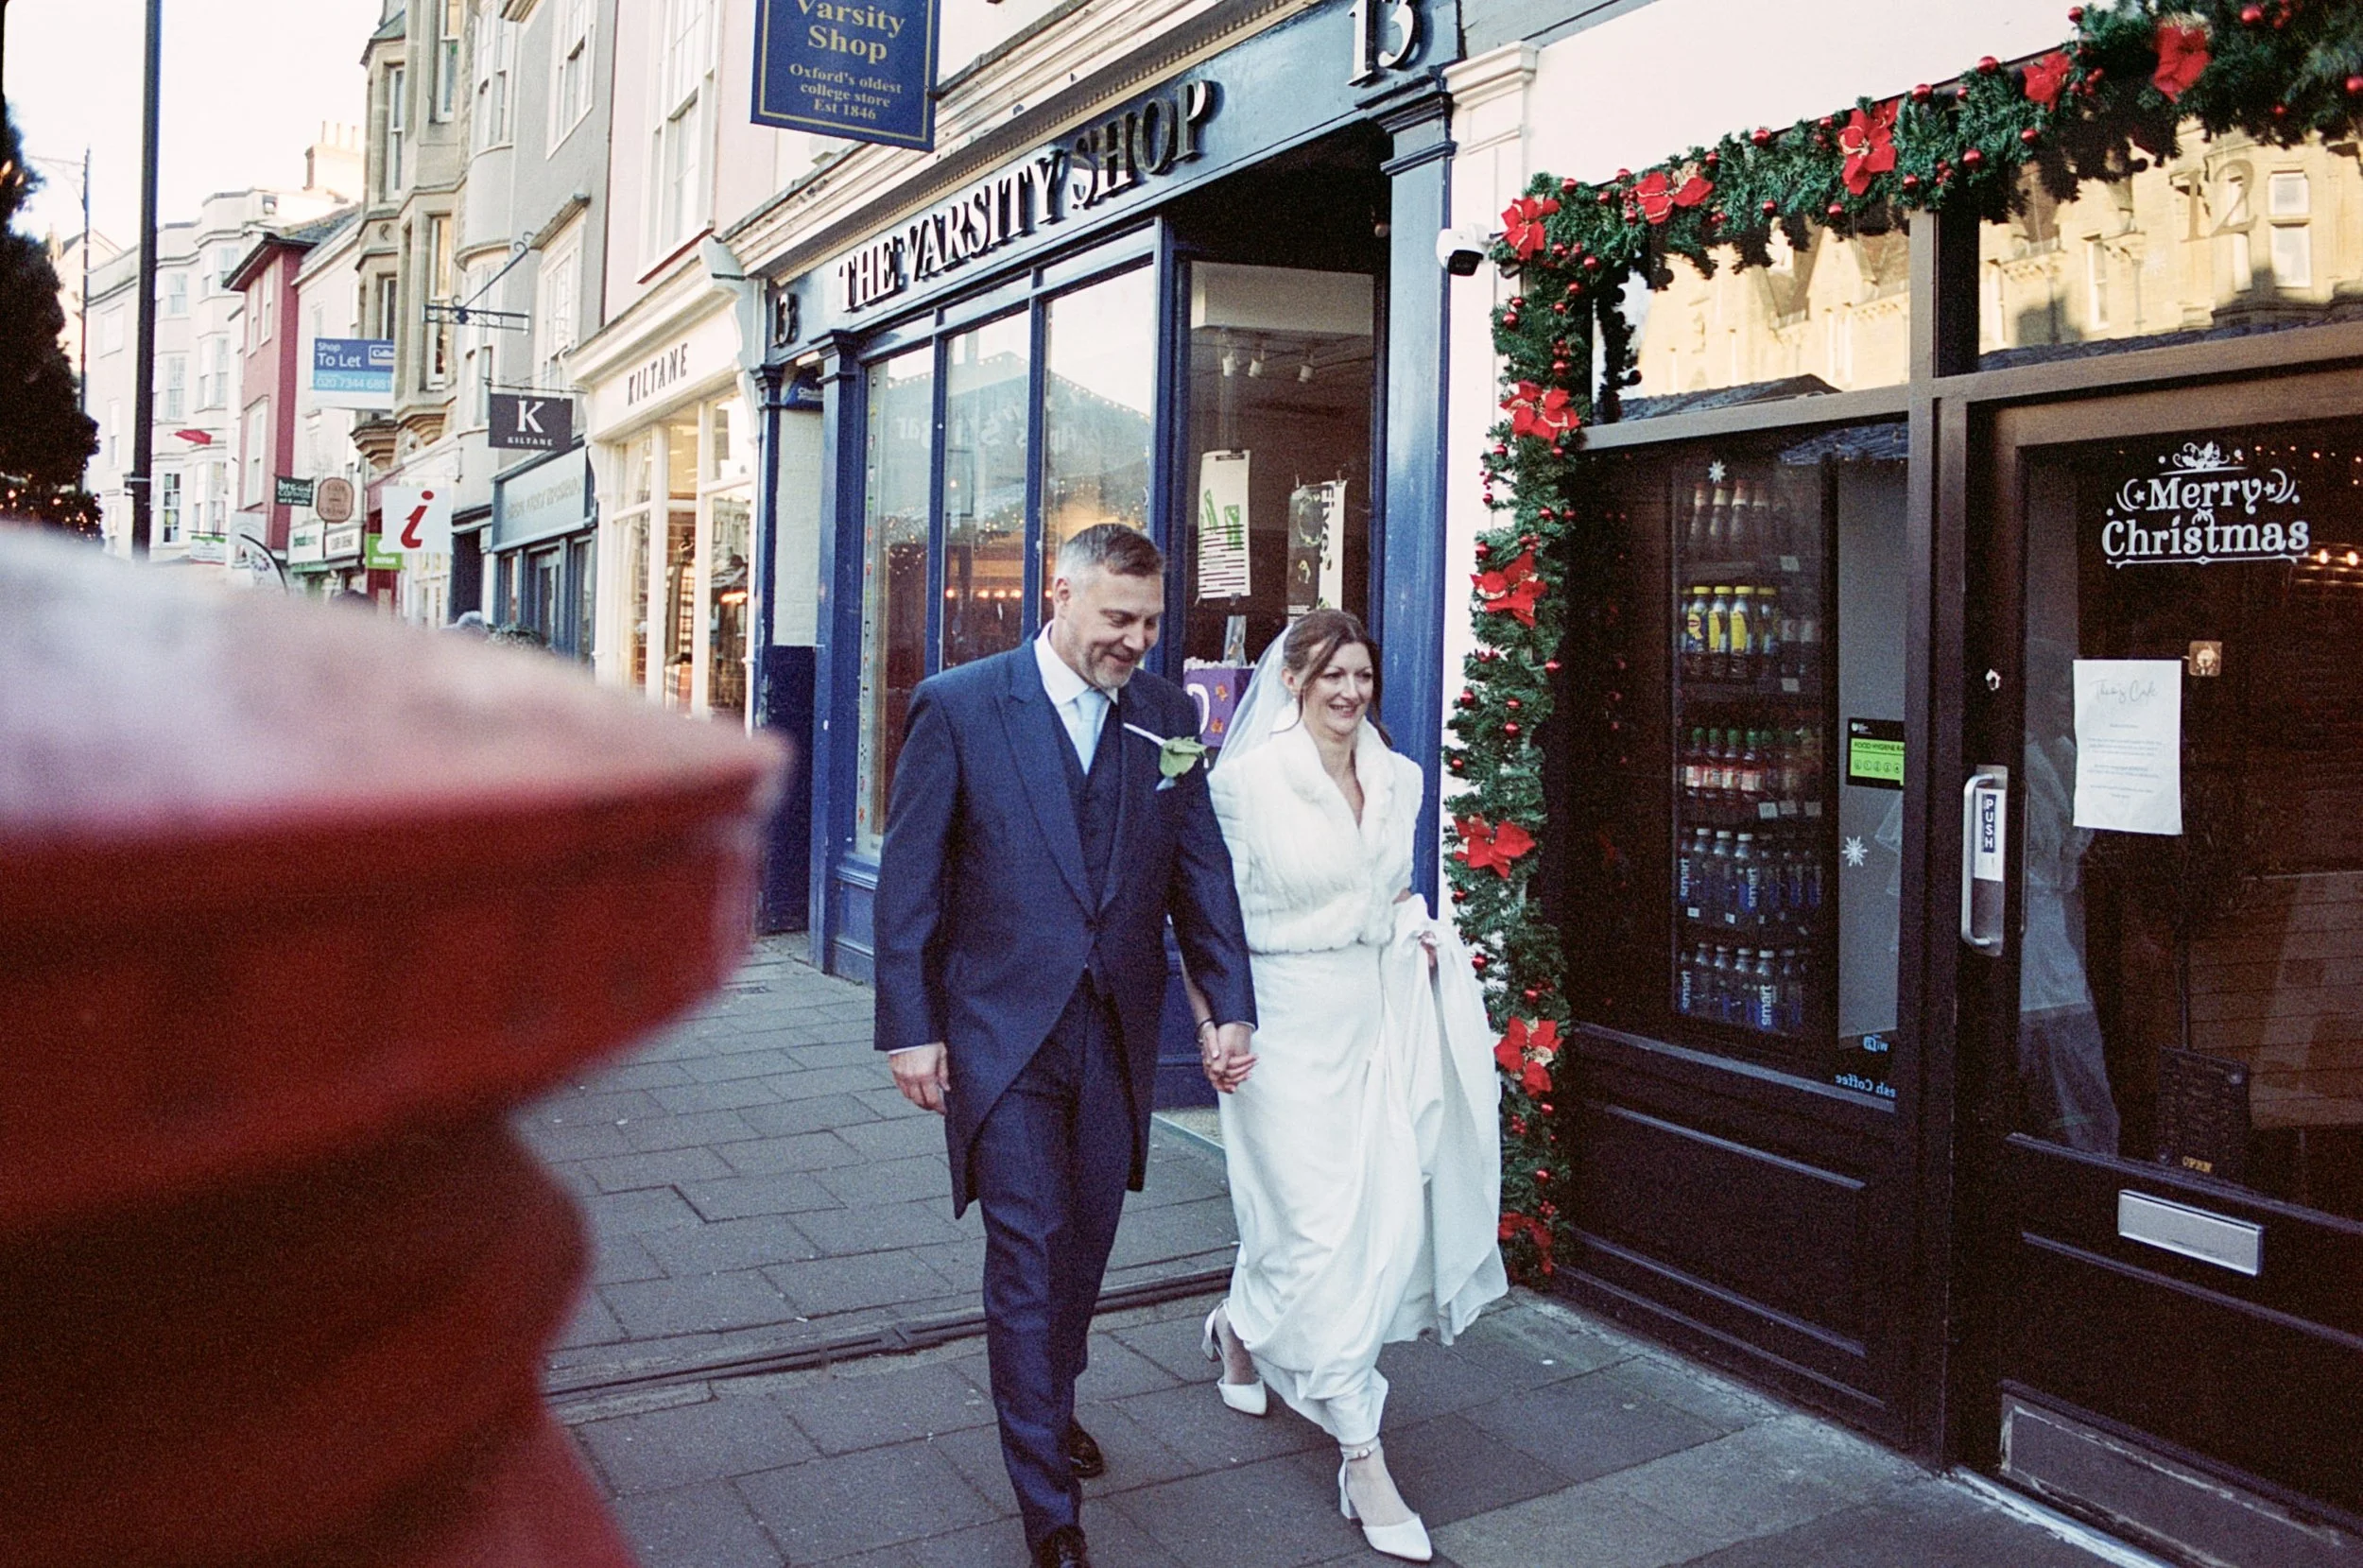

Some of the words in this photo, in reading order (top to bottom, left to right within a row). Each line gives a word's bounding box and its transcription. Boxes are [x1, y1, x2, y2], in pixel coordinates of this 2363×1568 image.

[796, 0, 906, 38] Varsity
[807, 25, 888, 64] Shop
[1347, 0, 1418, 85] 13
[789, 63, 855, 86] Oxford's
[859, 76, 903, 95] oldest
[800, 82, 850, 101] college
[854, 92, 890, 108] store
[813, 98, 837, 113] Est
[843, 104, 876, 120] 1846
[839, 234, 900, 313] THE
[906, 147, 1062, 283] VARSITY
[1071, 78, 1214, 210] SHOP
[2180, 159, 2259, 243] 12
[317, 342, 341, 353] Shop
[318, 353, 336, 367] To
[338, 353, 362, 368] Let
[628, 342, 688, 406] KILTANE
[517, 400, 545, 434] K
[507, 436, 554, 446] KILTANE
[2146, 476, 2262, 514] Merry
[2101, 514, 2310, 557] Christmas
[1985, 798, 1994, 849] PUSH
[1679, 857, 1690, 898] smart
[1747, 868, 1757, 908] smart
[1760, 984, 1772, 1026] smart
